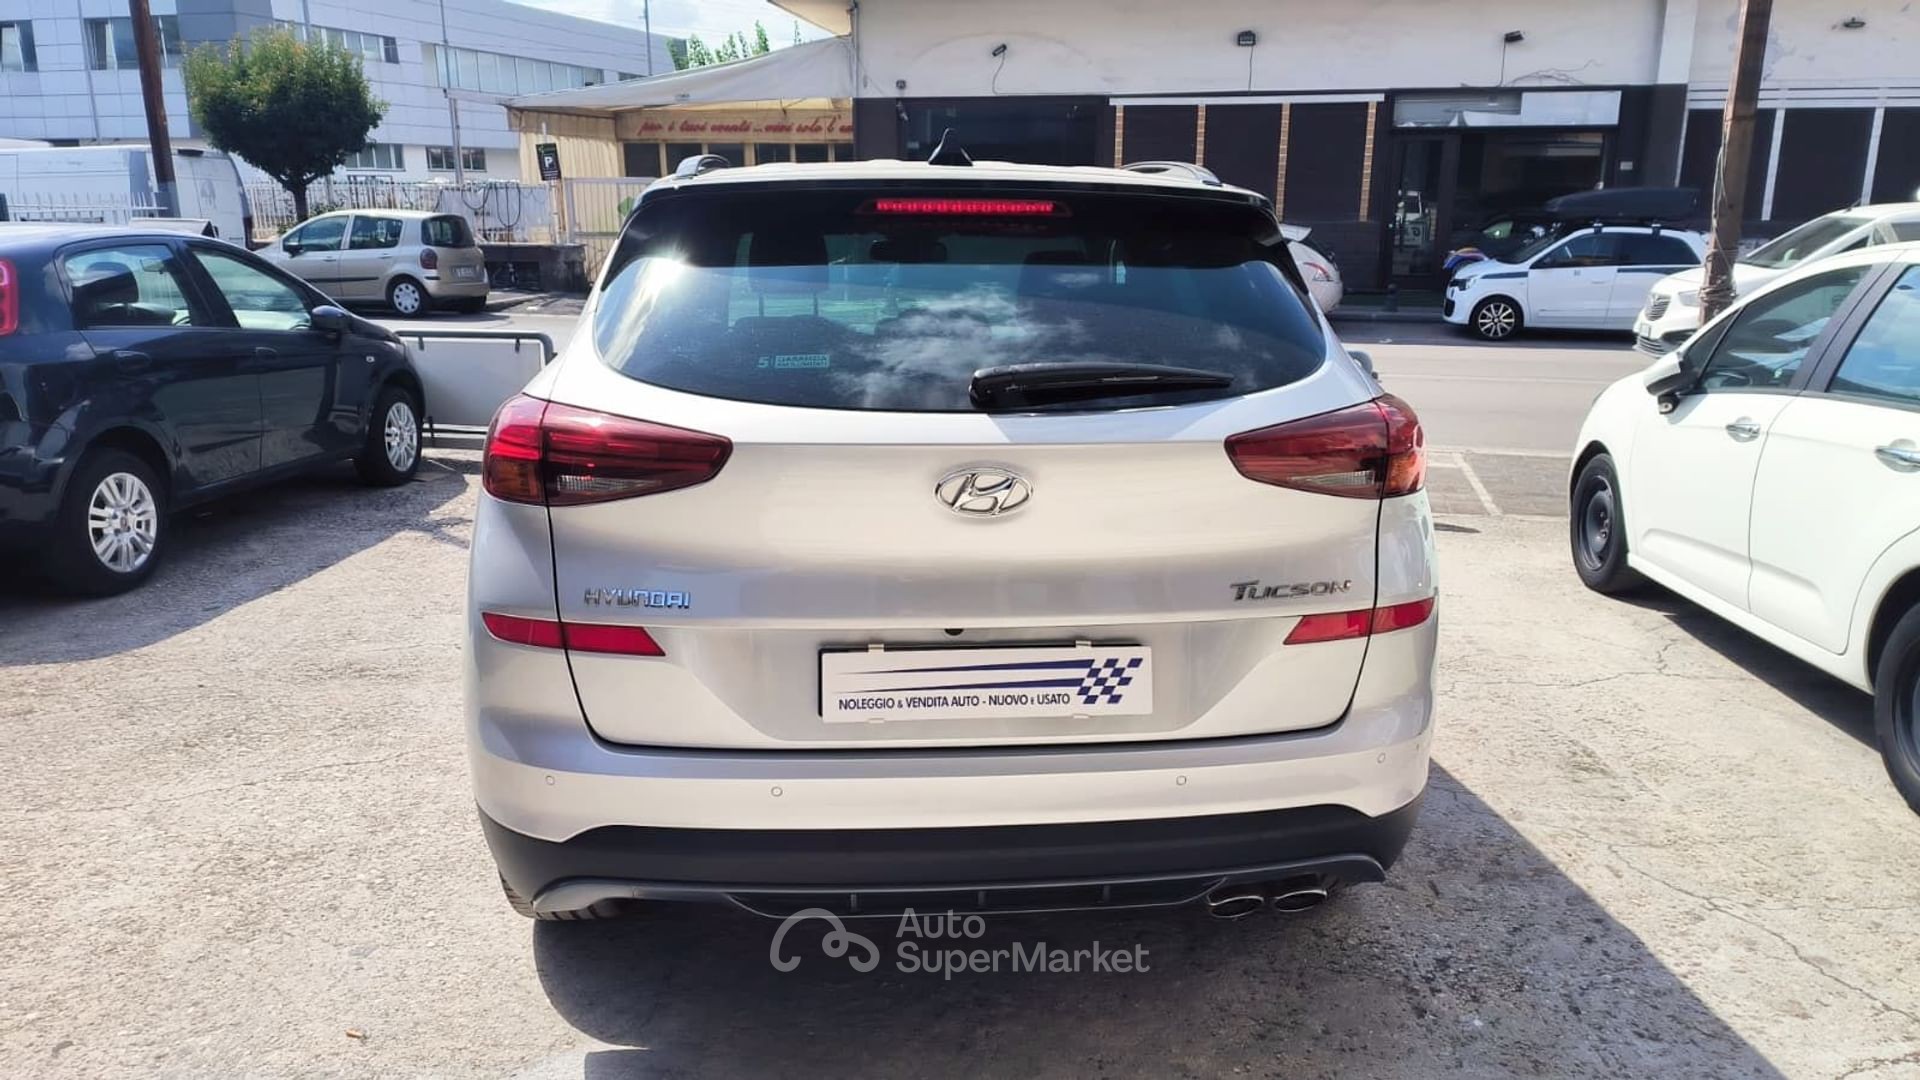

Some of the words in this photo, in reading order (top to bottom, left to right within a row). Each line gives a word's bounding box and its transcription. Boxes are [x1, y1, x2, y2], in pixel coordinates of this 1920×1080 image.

[544, 156, 553, 168] P
[584, 588, 691, 608] HYUNDAI
[838, 698, 895, 710] NOLEGGIO
[906, 696, 949, 708] VENDITA
[951, 696, 980, 706] AUTO
[988, 694, 1028, 705] NUOVO
[1036, 693, 1071, 705] USATO
